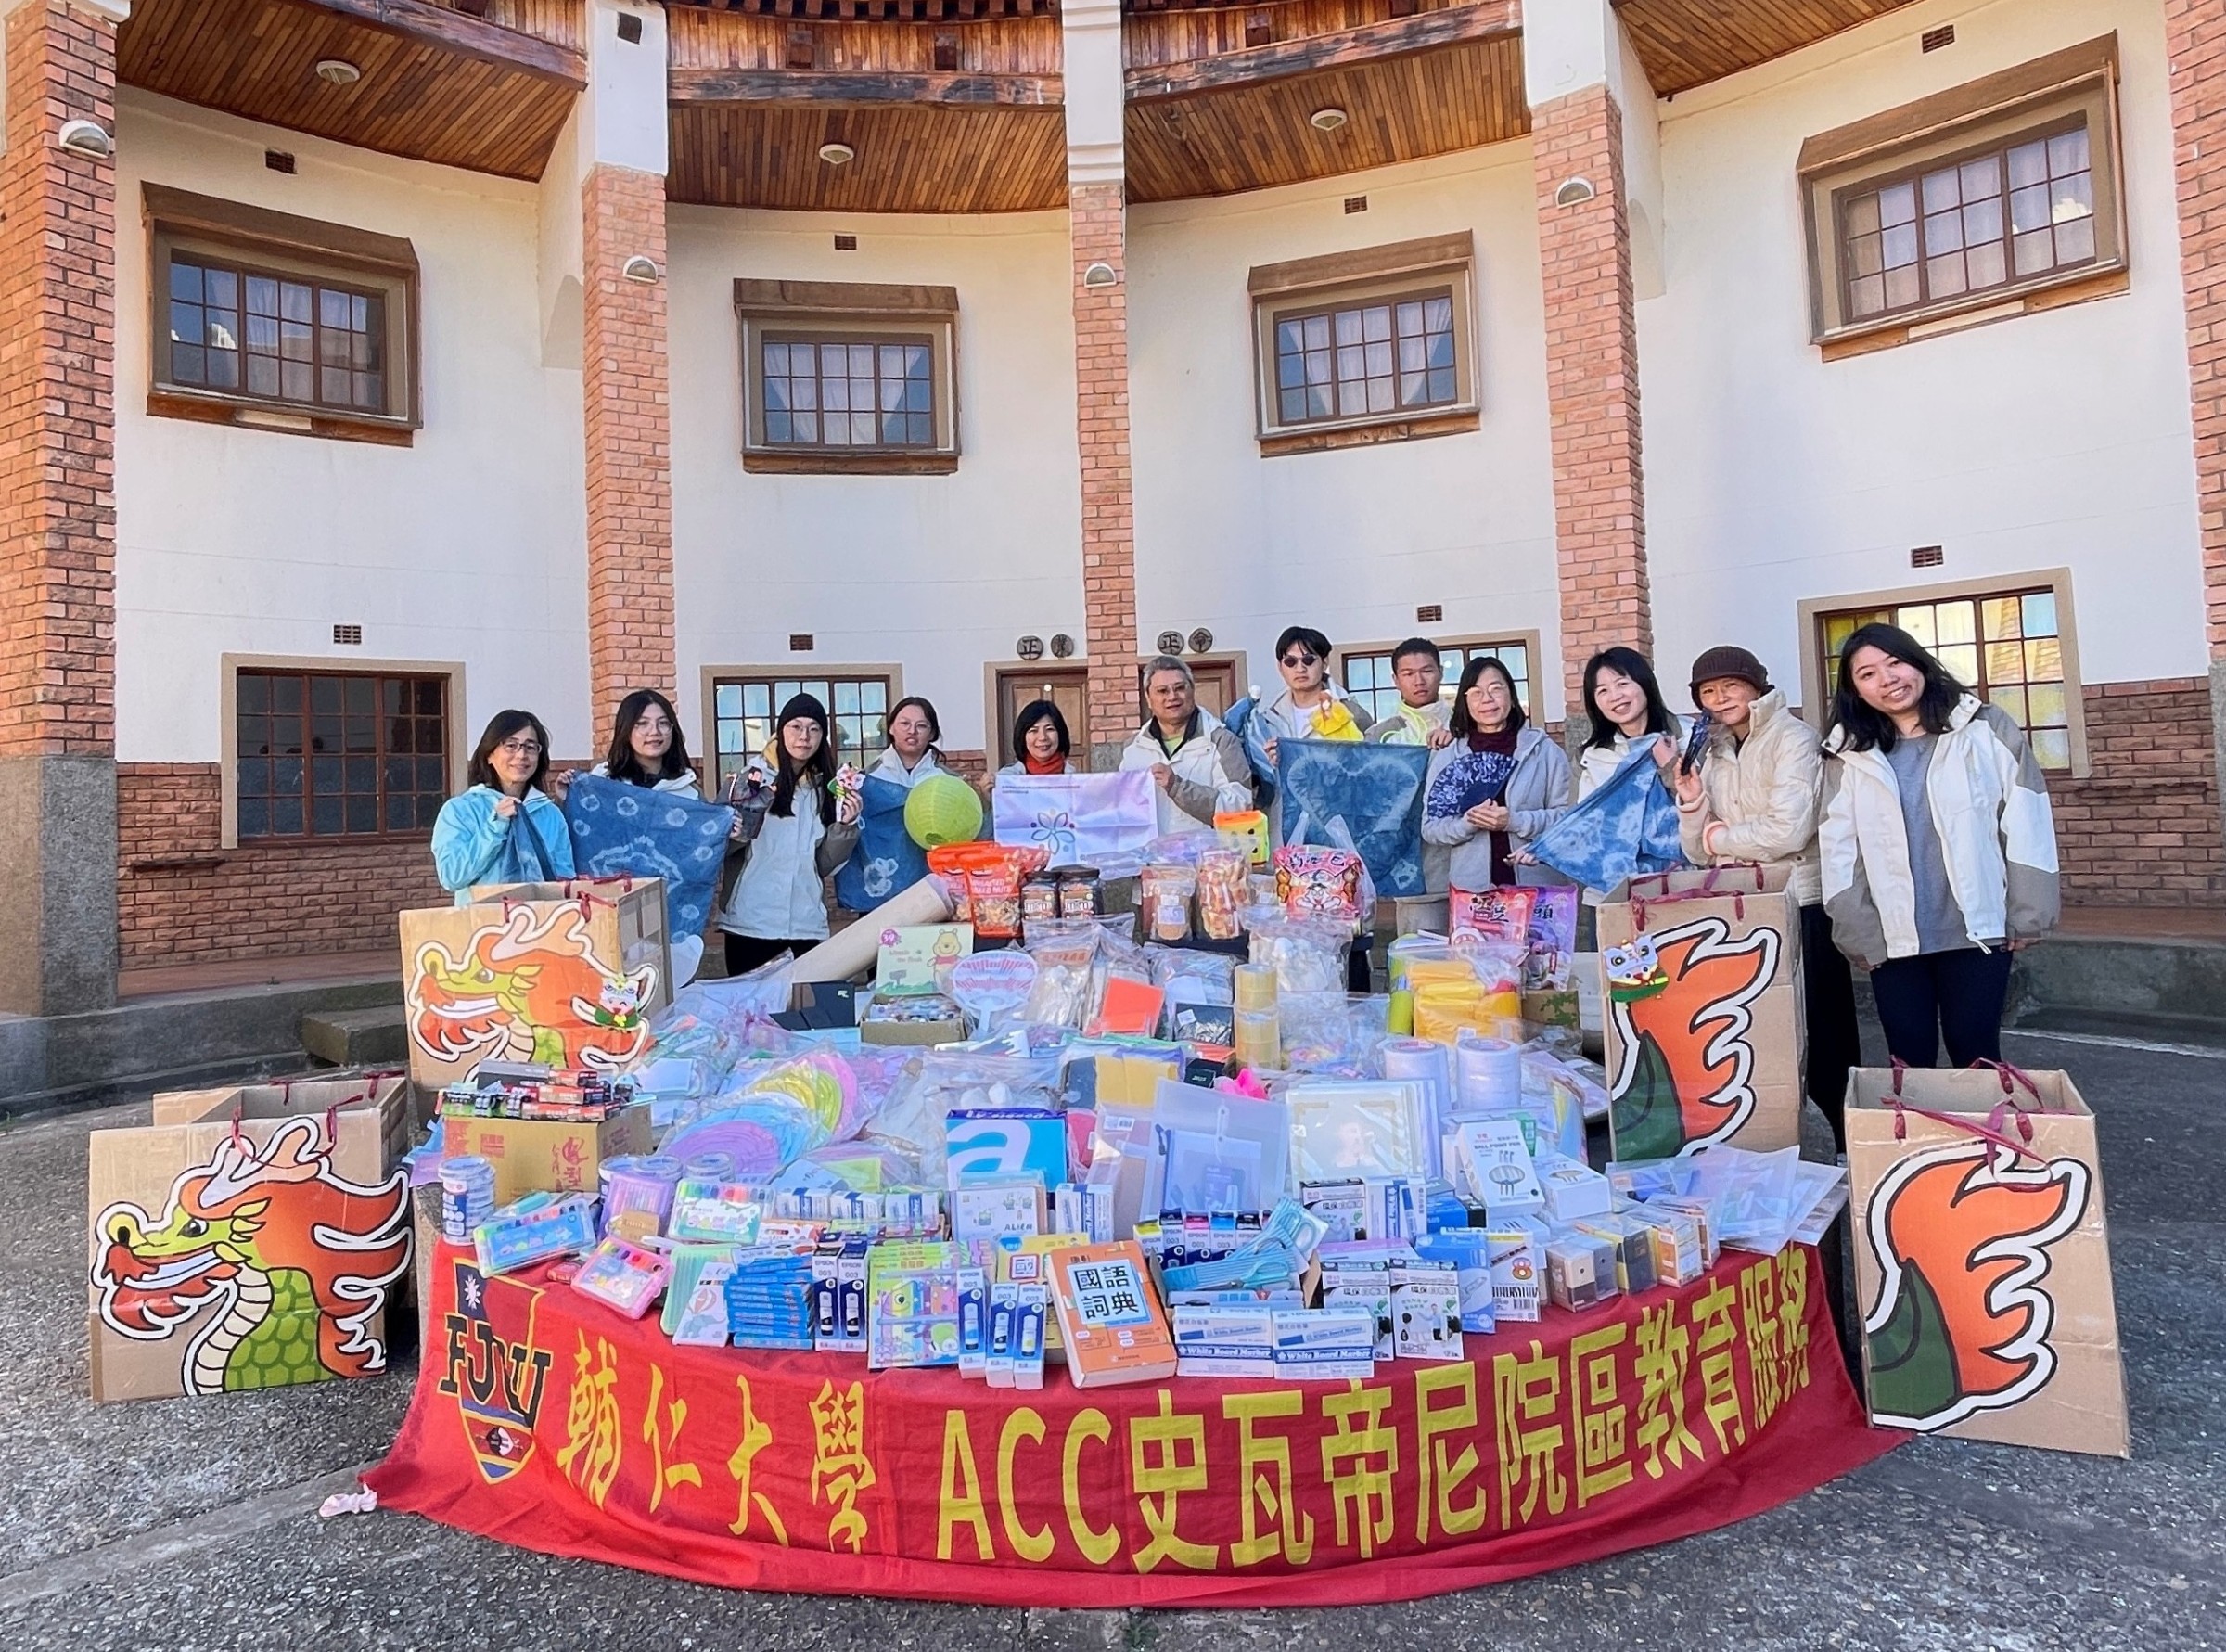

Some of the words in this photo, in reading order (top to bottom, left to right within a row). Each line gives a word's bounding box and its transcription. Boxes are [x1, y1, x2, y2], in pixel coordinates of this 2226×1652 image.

[1074, 1265, 1130, 1292] 國語
[1081, 1291, 1139, 1319] 詞典
[1188, 1346, 1214, 1355] White
[1215, 1347, 1241, 1355] Board
[1241, 1348, 1272, 1357] Marker
[1287, 1351, 1314, 1360] White
[1314, 1350, 1339, 1359] Board
[1339, 1349, 1371, 1358] Marker
[556, 1327, 877, 1556] 輔仁大學
